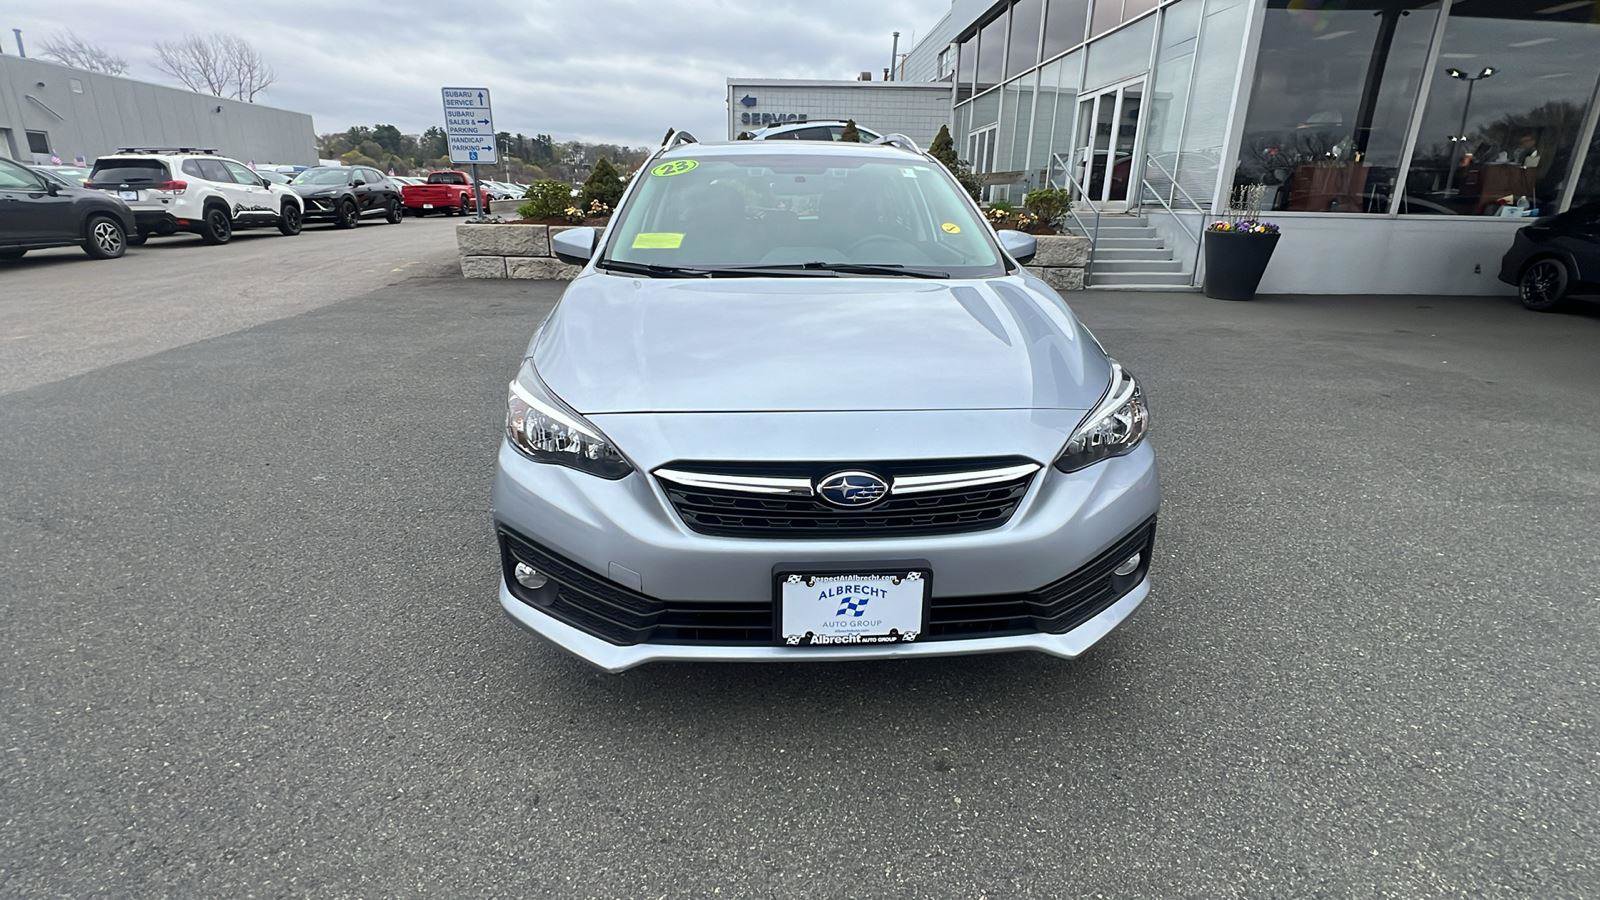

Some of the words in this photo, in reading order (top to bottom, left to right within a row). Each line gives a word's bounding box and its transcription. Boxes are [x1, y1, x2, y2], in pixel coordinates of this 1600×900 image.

[810, 574, 898, 583] RespectAtAlbrecht.com
[818, 584, 888, 601] ALBRECHT
[822, 620, 848, 628] AUTO
[849, 619, 882, 628] GROUP
[810, 633, 861, 645] Albrecht
